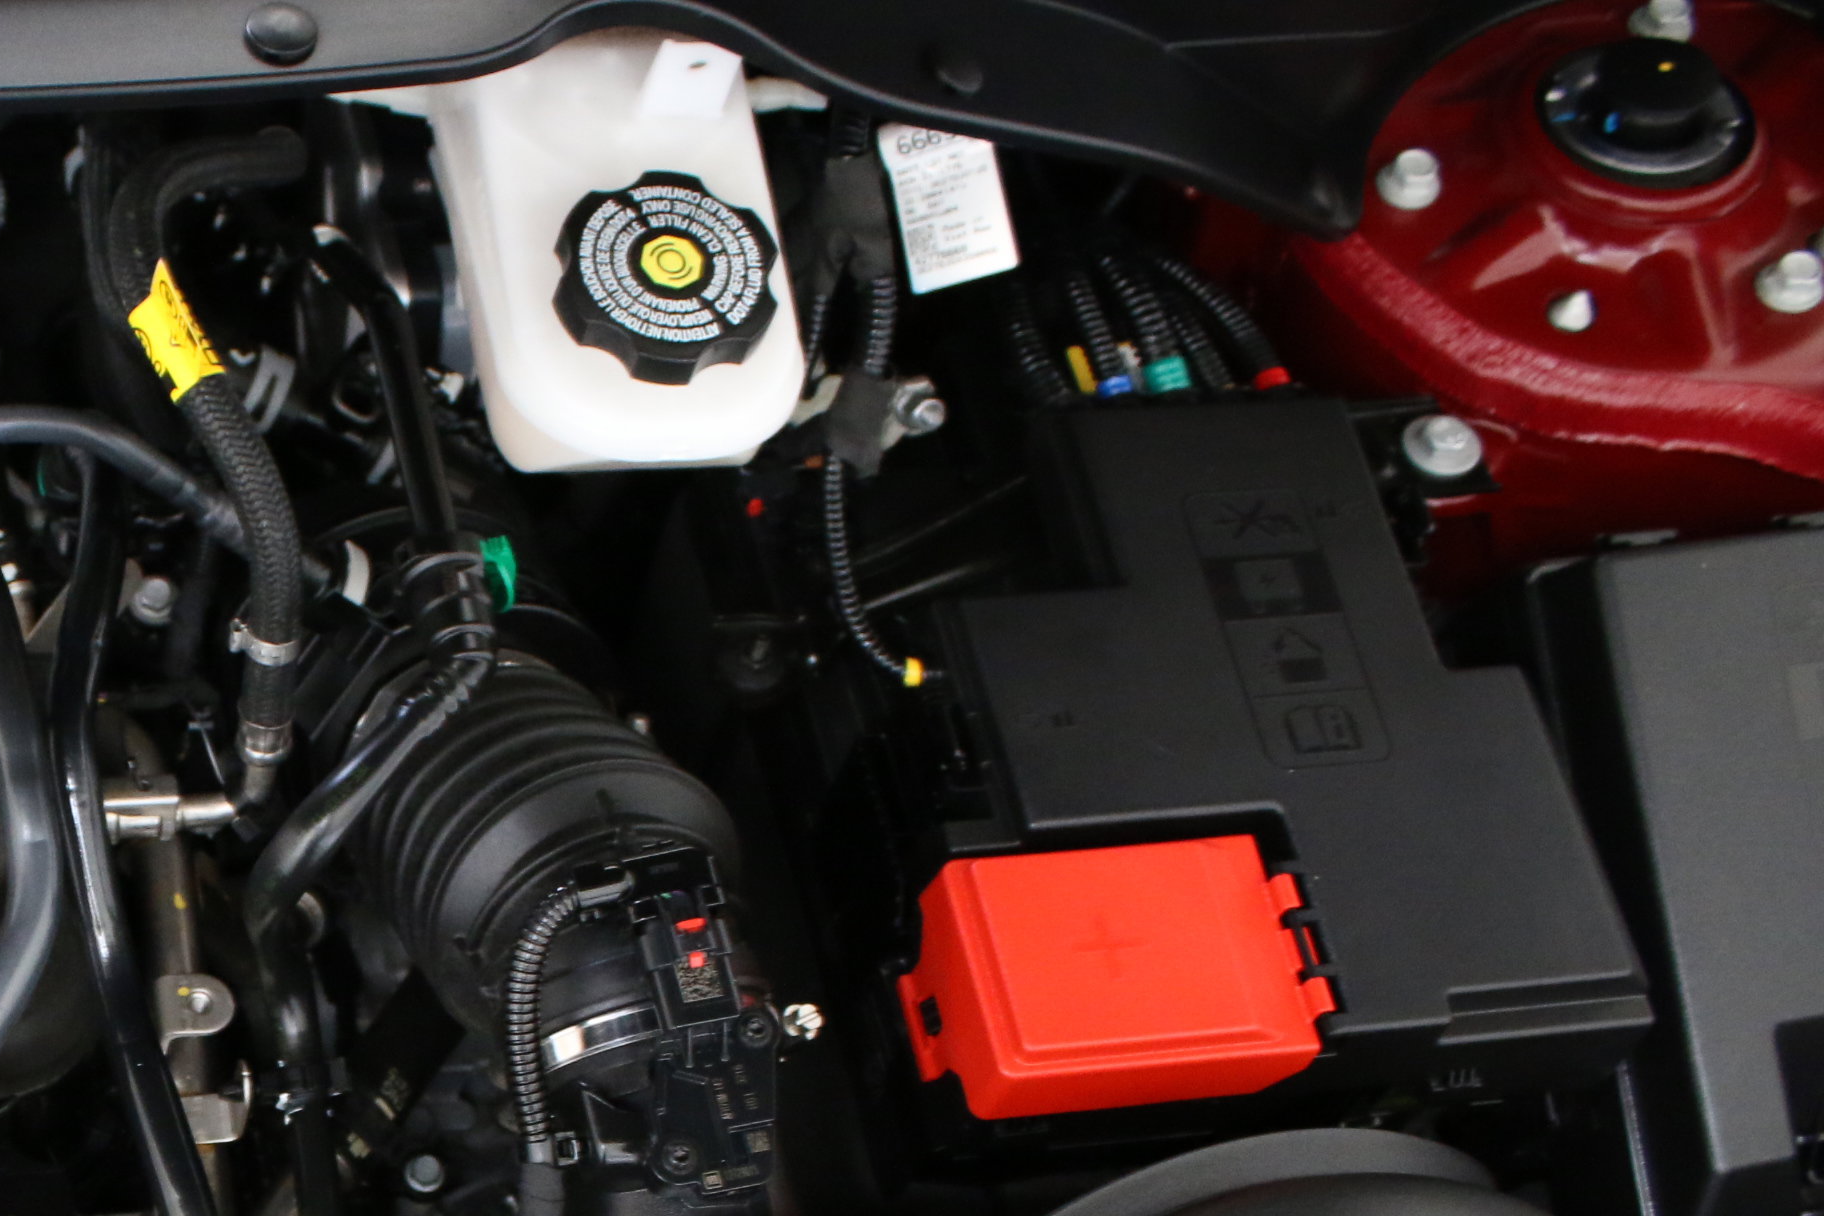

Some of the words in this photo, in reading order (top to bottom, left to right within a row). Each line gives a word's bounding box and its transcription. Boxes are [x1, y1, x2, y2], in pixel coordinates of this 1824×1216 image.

[628, 185, 701, 204] CONTAINER
[641, 199, 671, 215] ONLY
[670, 200, 696, 216] USE
[647, 213, 689, 230] FILLER
[701, 197, 743, 232] SEALED
[579, 228, 597, 257] AVANT
[687, 220, 723, 254] CLEAN
[694, 206, 742, 255] REMOVING
[740, 235, 762, 267] FROM
[579, 257, 608, 301] BOUCHON
[728, 253, 746, 295] BEFORE
[598, 298, 616, 313] LE
[714, 290, 737, 313] CAP
